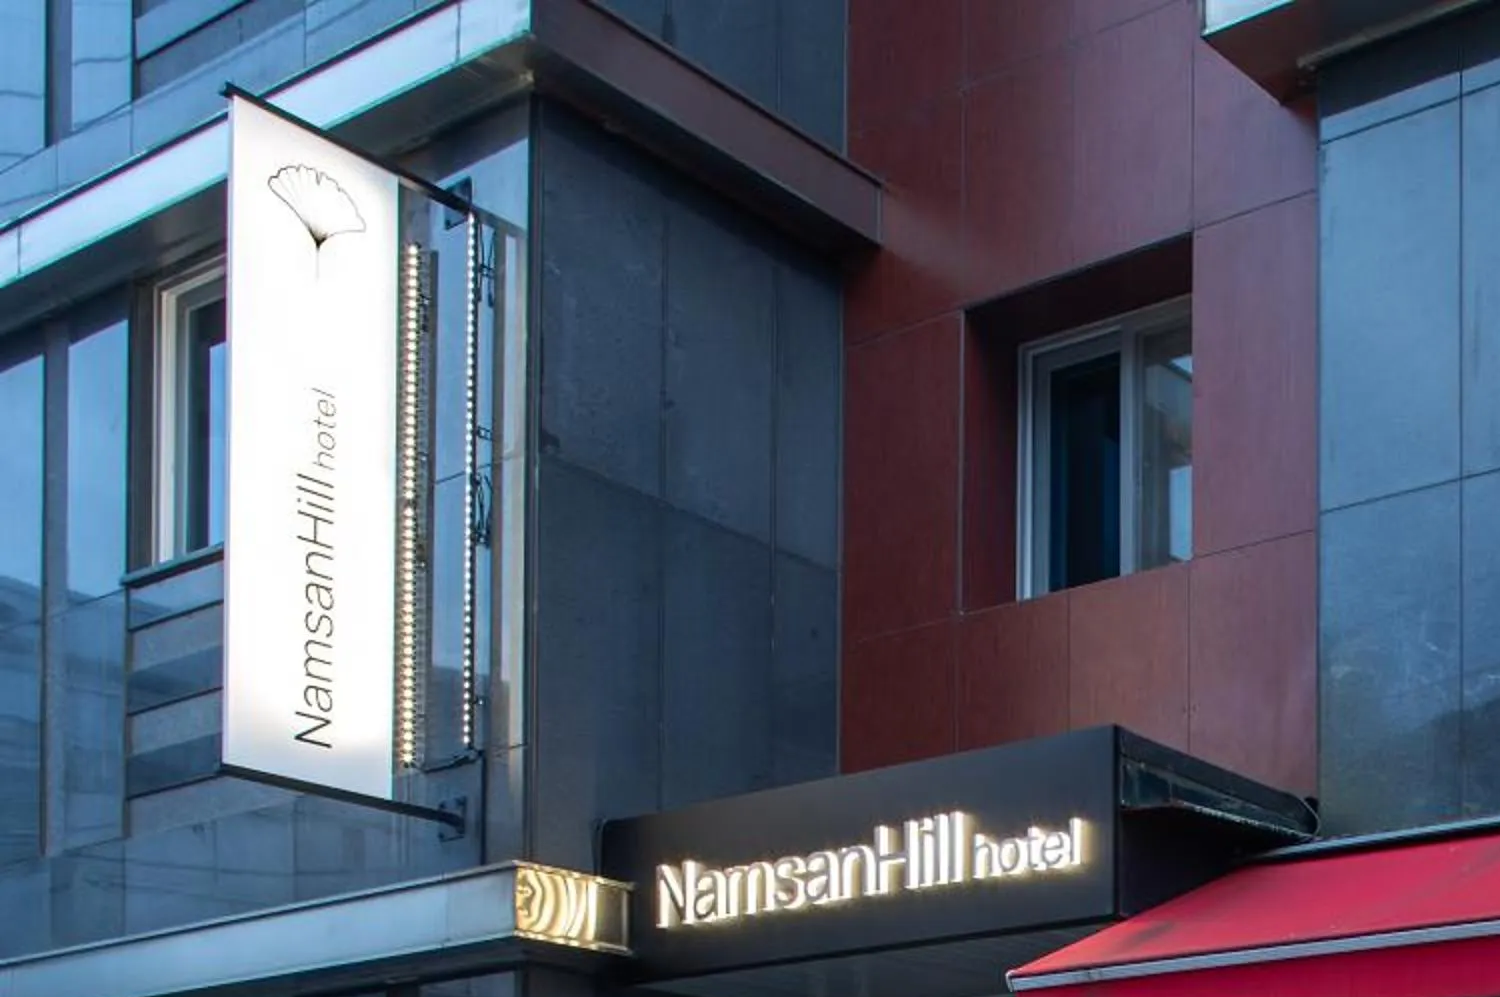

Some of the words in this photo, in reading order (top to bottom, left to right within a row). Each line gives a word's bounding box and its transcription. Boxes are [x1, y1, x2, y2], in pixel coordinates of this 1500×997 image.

[311, 387, 337, 472] hotel
[293, 472, 335, 750] NamsanHill
[655, 810, 970, 929] NamsanHill
[973, 816, 1088, 880] hotel
